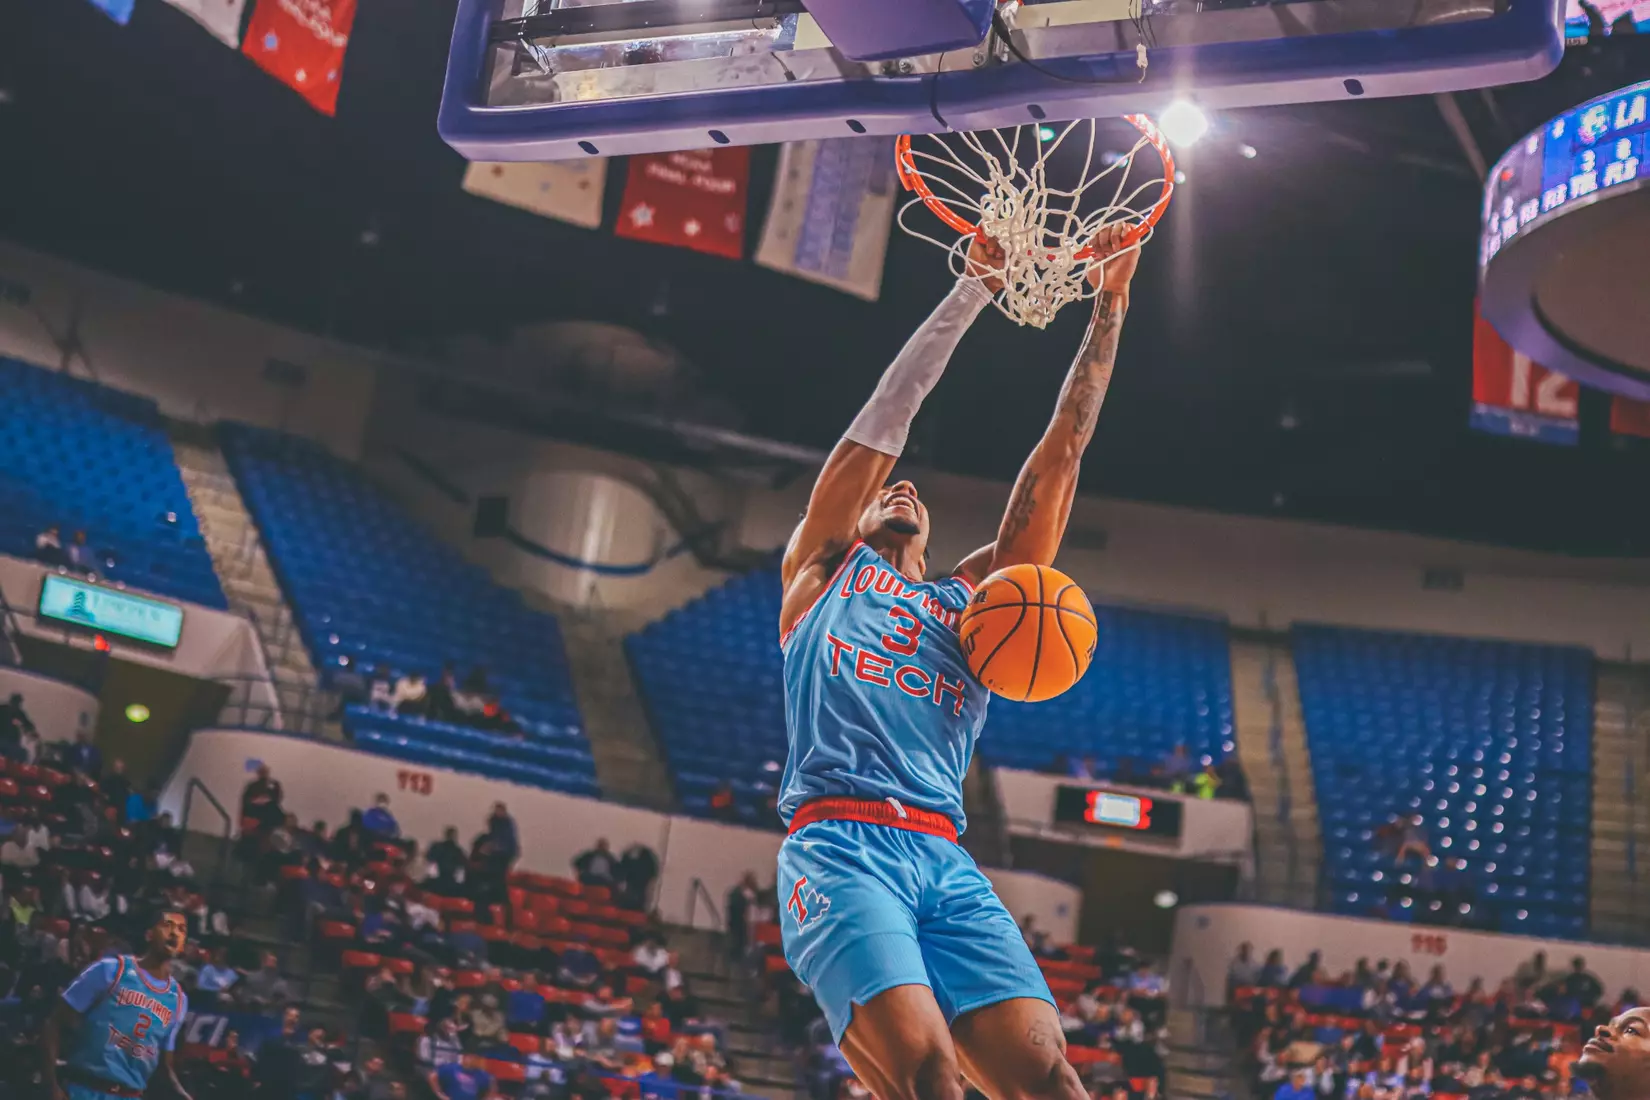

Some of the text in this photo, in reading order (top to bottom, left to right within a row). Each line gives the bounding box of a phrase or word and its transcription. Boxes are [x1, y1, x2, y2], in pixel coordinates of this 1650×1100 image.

[881, 604, 924, 657] 3
[826, 630, 966, 717] TECH
[134, 1013, 152, 1039] 2
